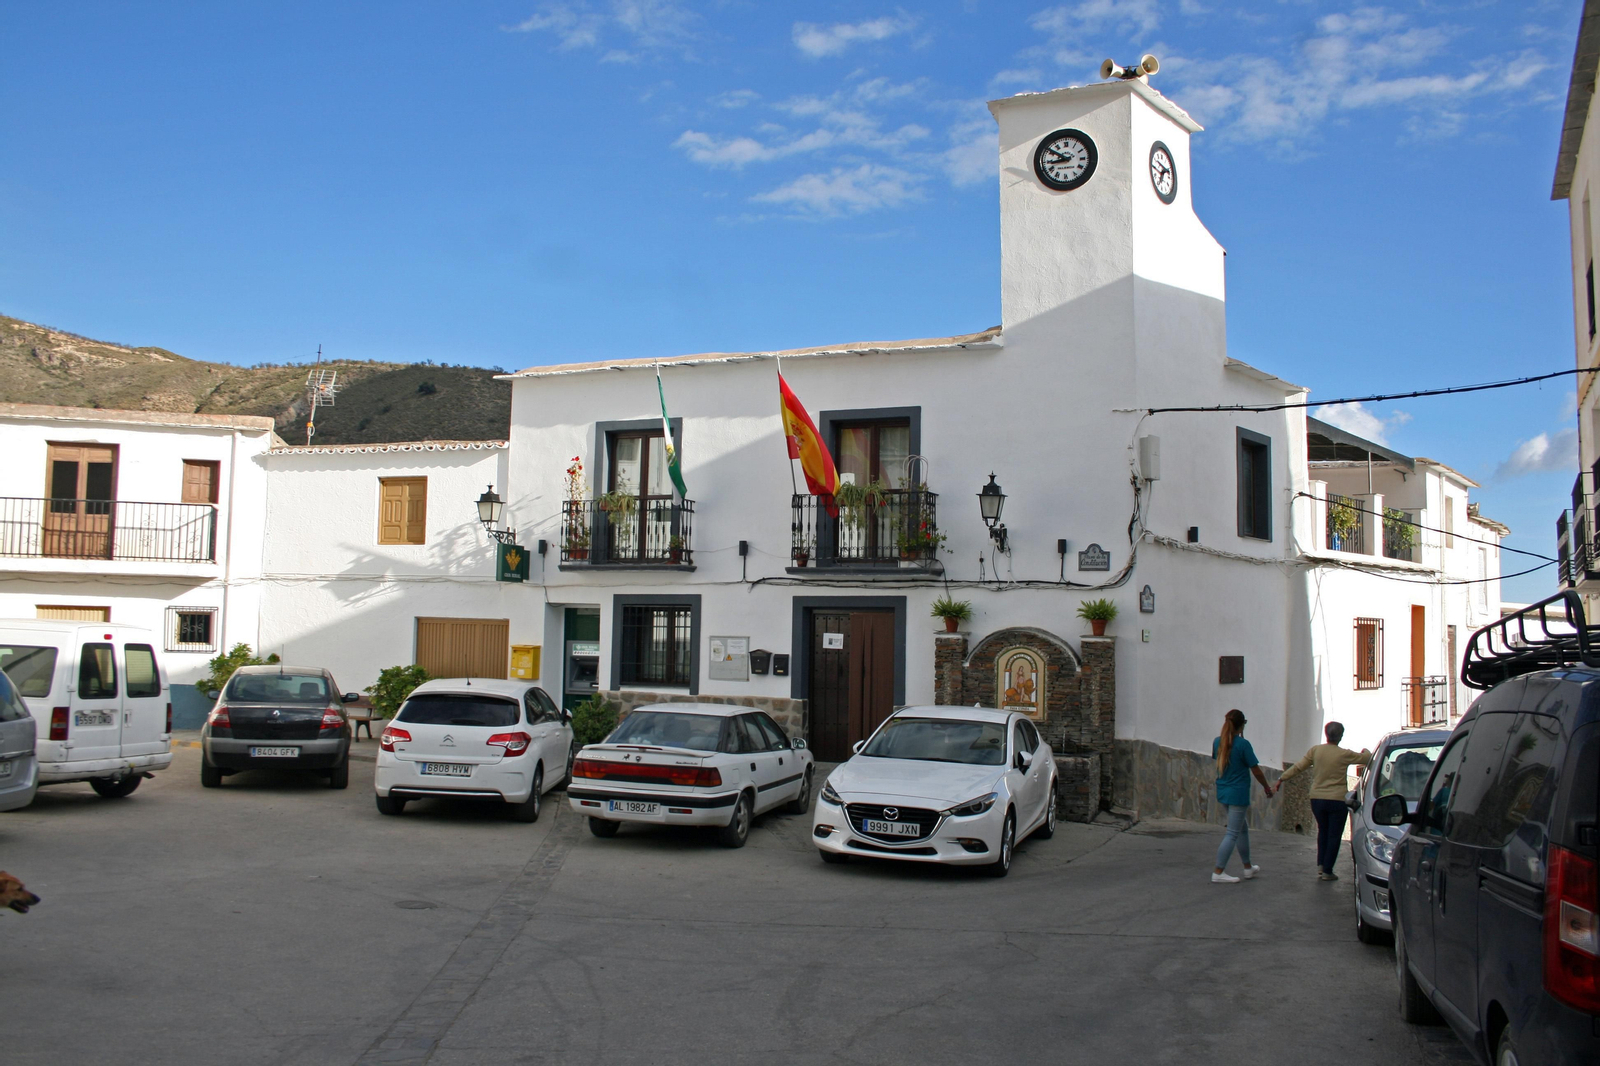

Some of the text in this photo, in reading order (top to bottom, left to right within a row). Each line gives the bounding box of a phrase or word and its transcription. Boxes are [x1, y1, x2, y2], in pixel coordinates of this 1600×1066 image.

[256, 748, 296, 756] 8404 GFK
[427, 763, 469, 774] 6808 HVM
[613, 801, 658, 813] AL 1982 AF
[869, 821, 918, 835] 9991 JXN
